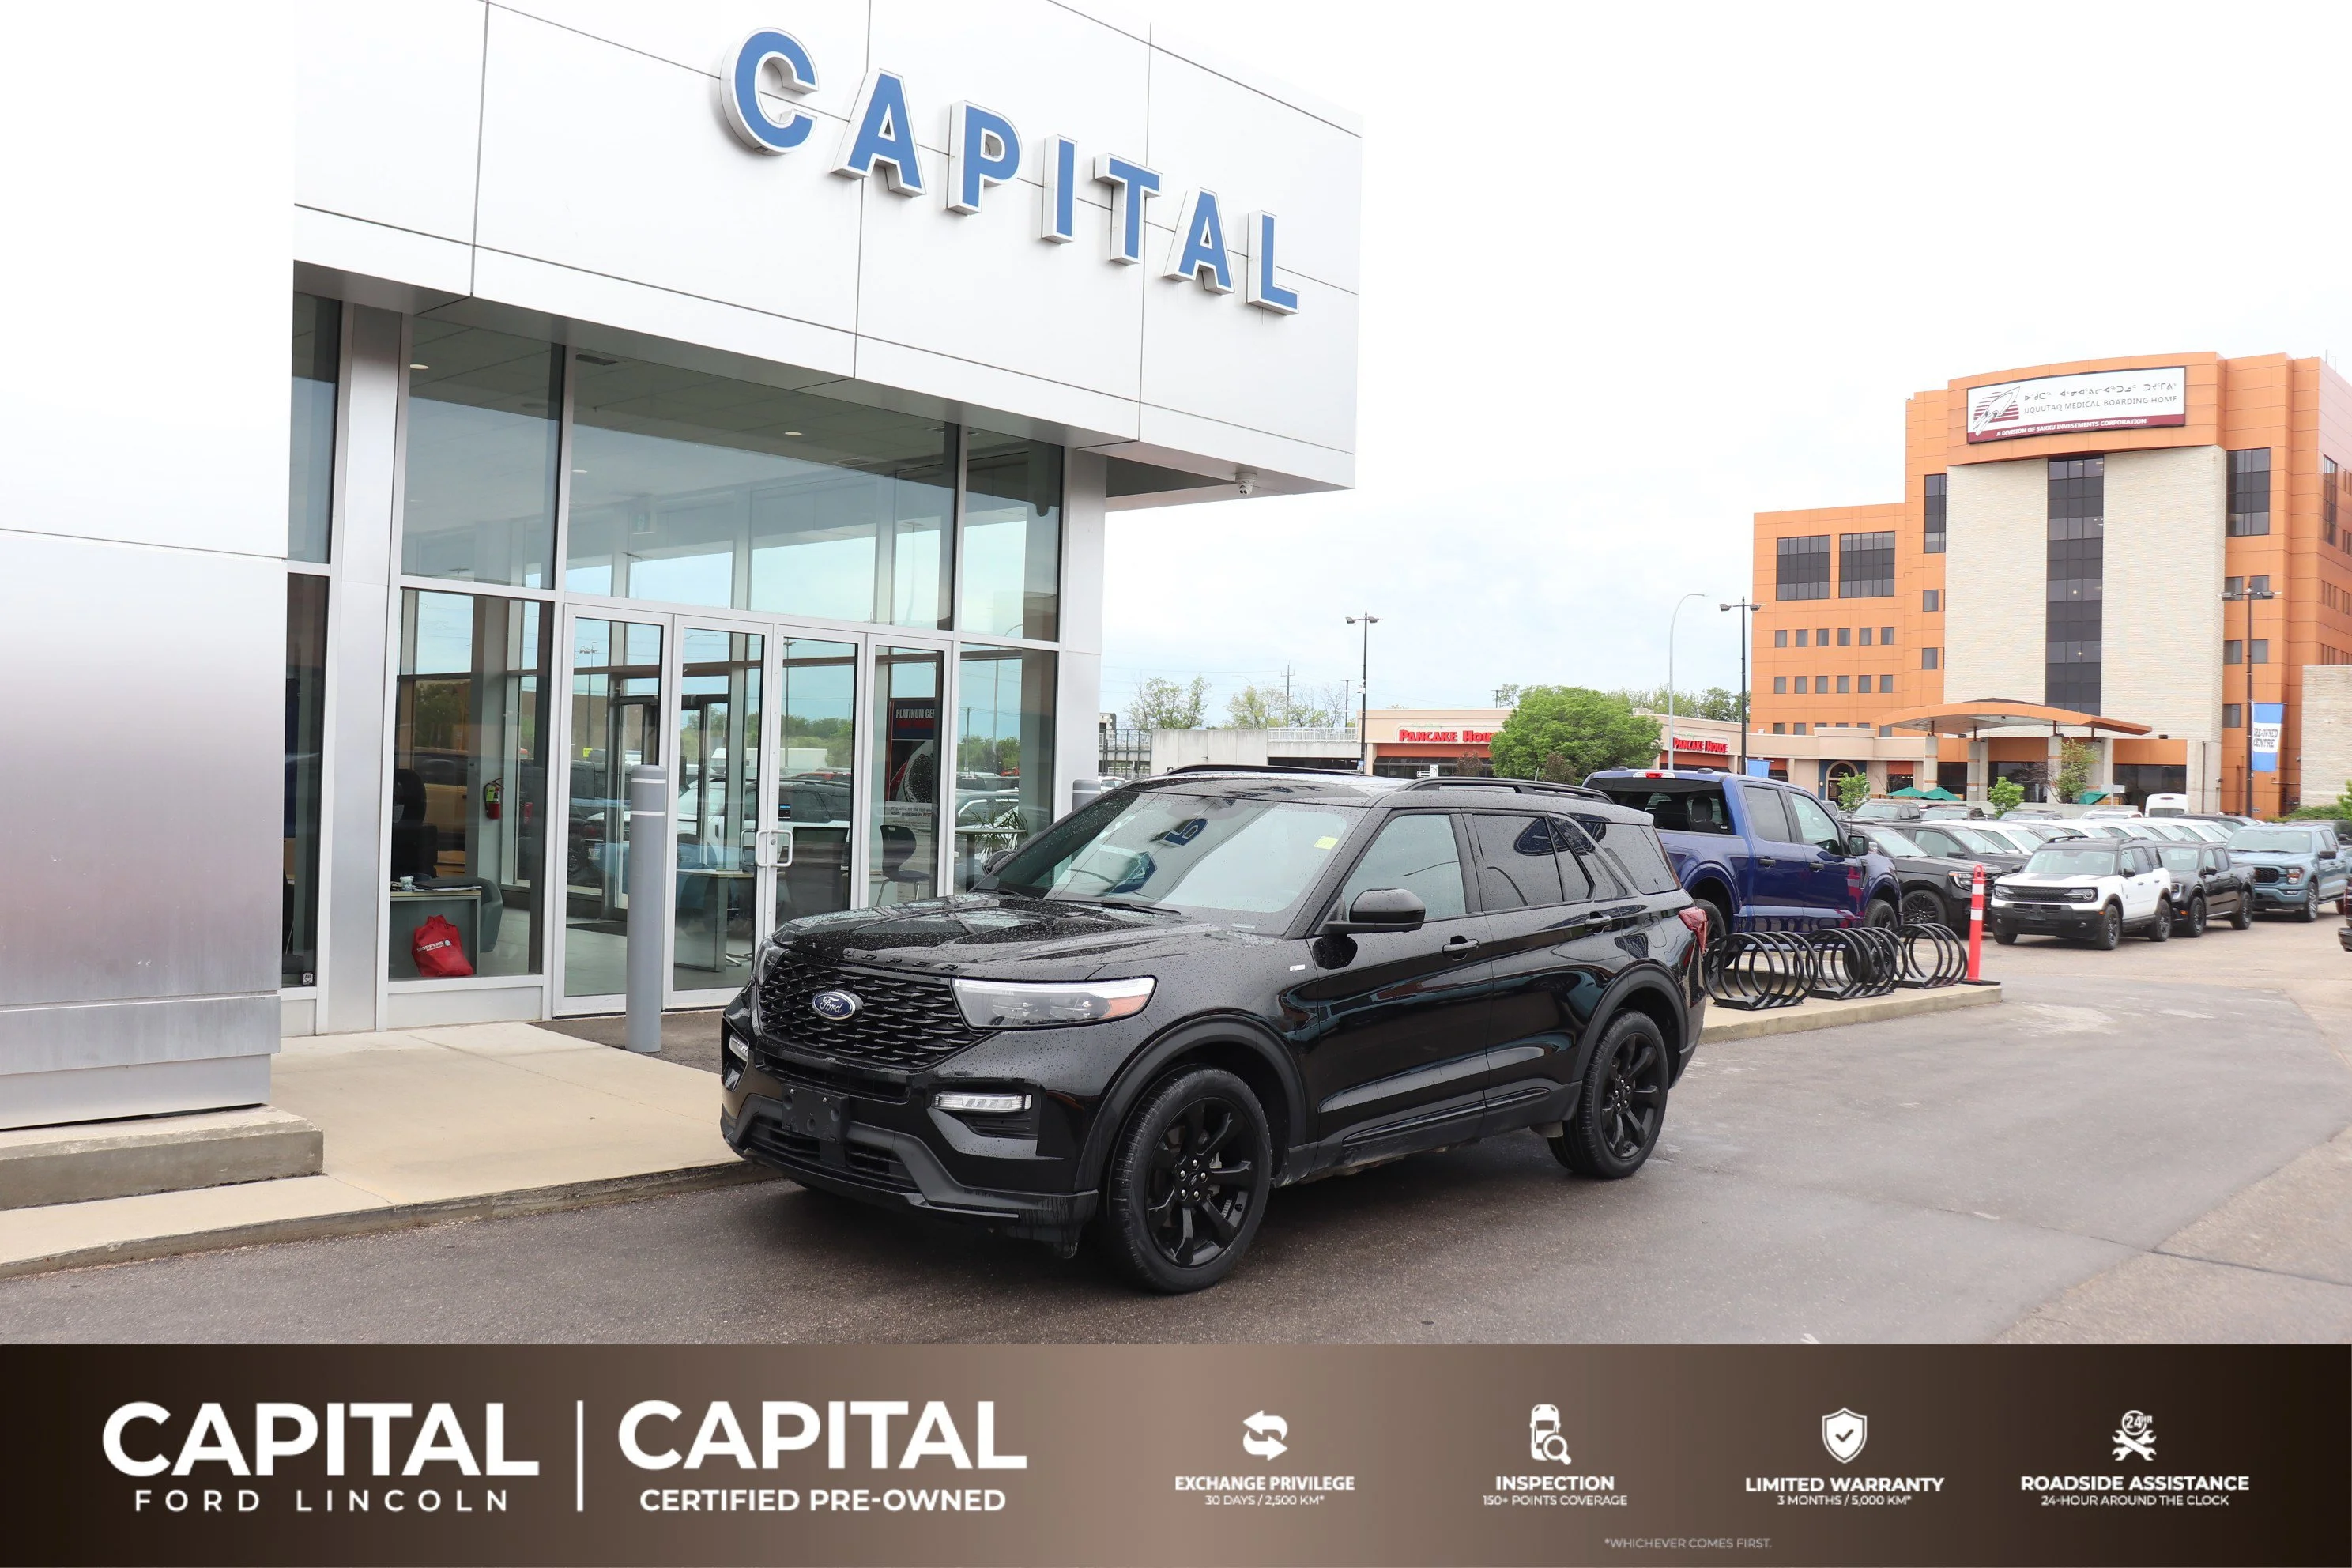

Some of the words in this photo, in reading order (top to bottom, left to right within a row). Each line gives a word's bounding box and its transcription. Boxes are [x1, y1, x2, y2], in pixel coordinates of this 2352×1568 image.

[720, 27, 1299, 315] CAPITAL
[2024, 404, 2063, 414] UQUUTAQ
[2064, 401, 2100, 409] MEDICAL
[2104, 397, 2148, 406] BOARDING
[895, 708, 924, 718] PLATINUM
[1399, 729, 1458, 742] PANCAKE
[1463, 730, 1496, 742] HOU
[1673, 737, 1705, 751] PANCAKE
[1705, 741, 1728, 753] HOUSE
[819, 995, 844, 1014] Ford
